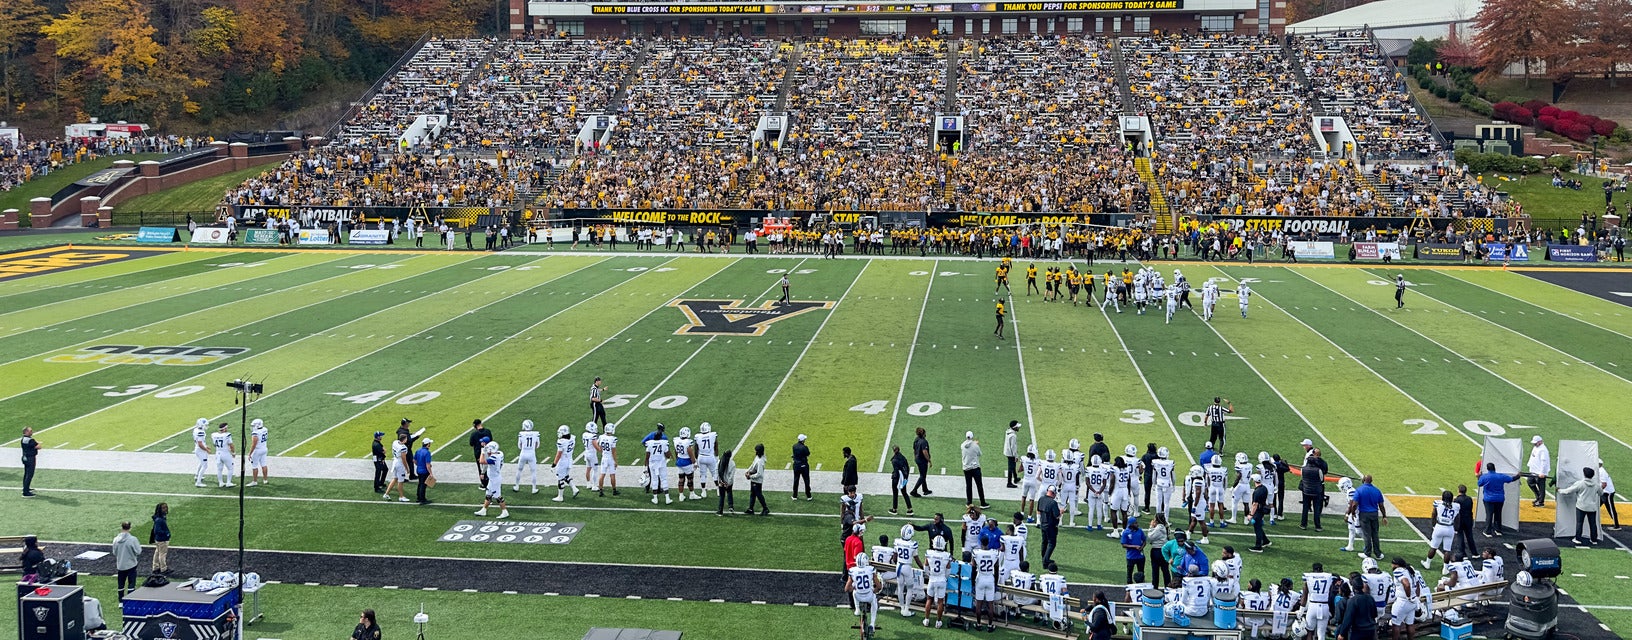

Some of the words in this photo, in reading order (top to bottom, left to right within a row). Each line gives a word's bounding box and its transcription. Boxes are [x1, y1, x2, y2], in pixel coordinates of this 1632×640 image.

[1079, 2, 1123, 10] SPONSORING
[299, 208, 354, 222] FOTBALL
[613, 212, 667, 223] WELCOME
[690, 212, 721, 223] ROCK
[833, 213, 861, 223] STAT
[1244, 219, 1283, 232] STATE
[848, 400, 944, 417] 40
[1402, 418, 1507, 436] 20
[526, 437, 533, 447] 11
[702, 438, 711, 450] 71
[652, 444, 663, 455] 74
[1027, 465, 1034, 475] 5
[1044, 468, 1056, 480] 88
[1066, 471, 1073, 481] 0
[1160, 467, 1167, 477] 6
[1090, 473, 1102, 485] 86
[1211, 475, 1223, 483] 23
[970, 525, 981, 535] 23
[897, 547, 910, 560] 28
[1010, 544, 1018, 555] 5
[933, 560, 942, 573] 3
[980, 559, 994, 572] 22
[856, 574, 870, 590] 26
[1045, 581, 1056, 594] 14
[1313, 579, 1328, 595] 47
[1197, 585, 1204, 598] 2
[1377, 583, 1384, 596] 8
[1250, 600, 1264, 611] 54
[1276, 593, 1291, 609] 46
